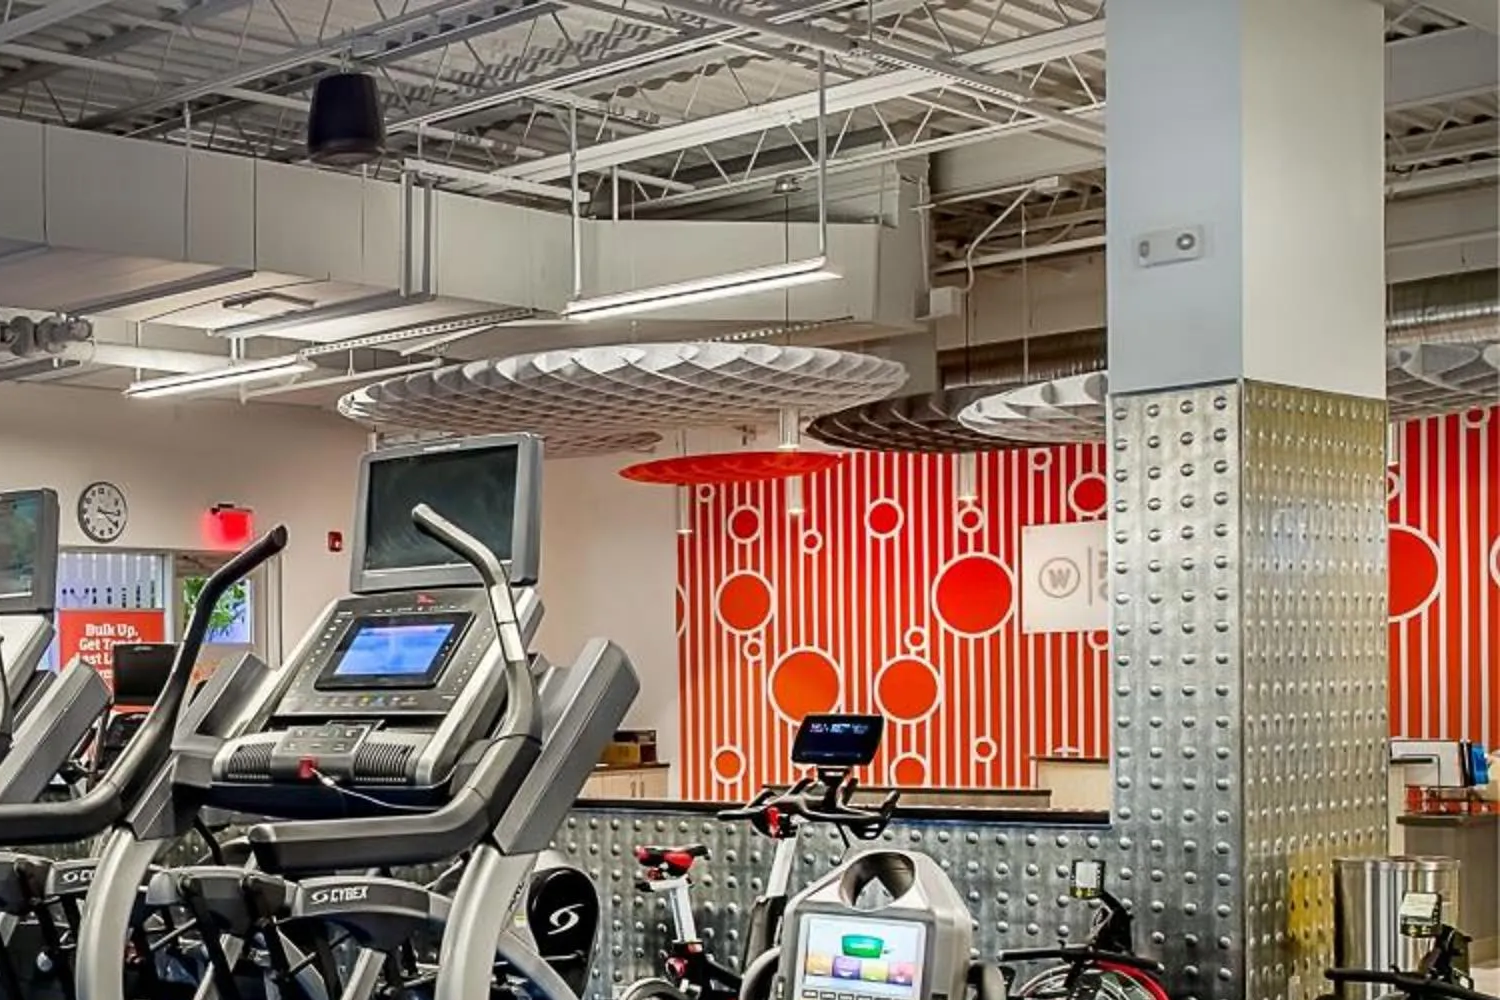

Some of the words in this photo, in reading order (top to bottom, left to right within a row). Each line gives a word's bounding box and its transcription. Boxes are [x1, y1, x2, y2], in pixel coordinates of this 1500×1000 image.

[85, 623, 116, 637] Bulk
[117, 623, 139, 641] Up.
[79, 637, 101, 651] Get
[330, 885, 369, 903] CYBEX
